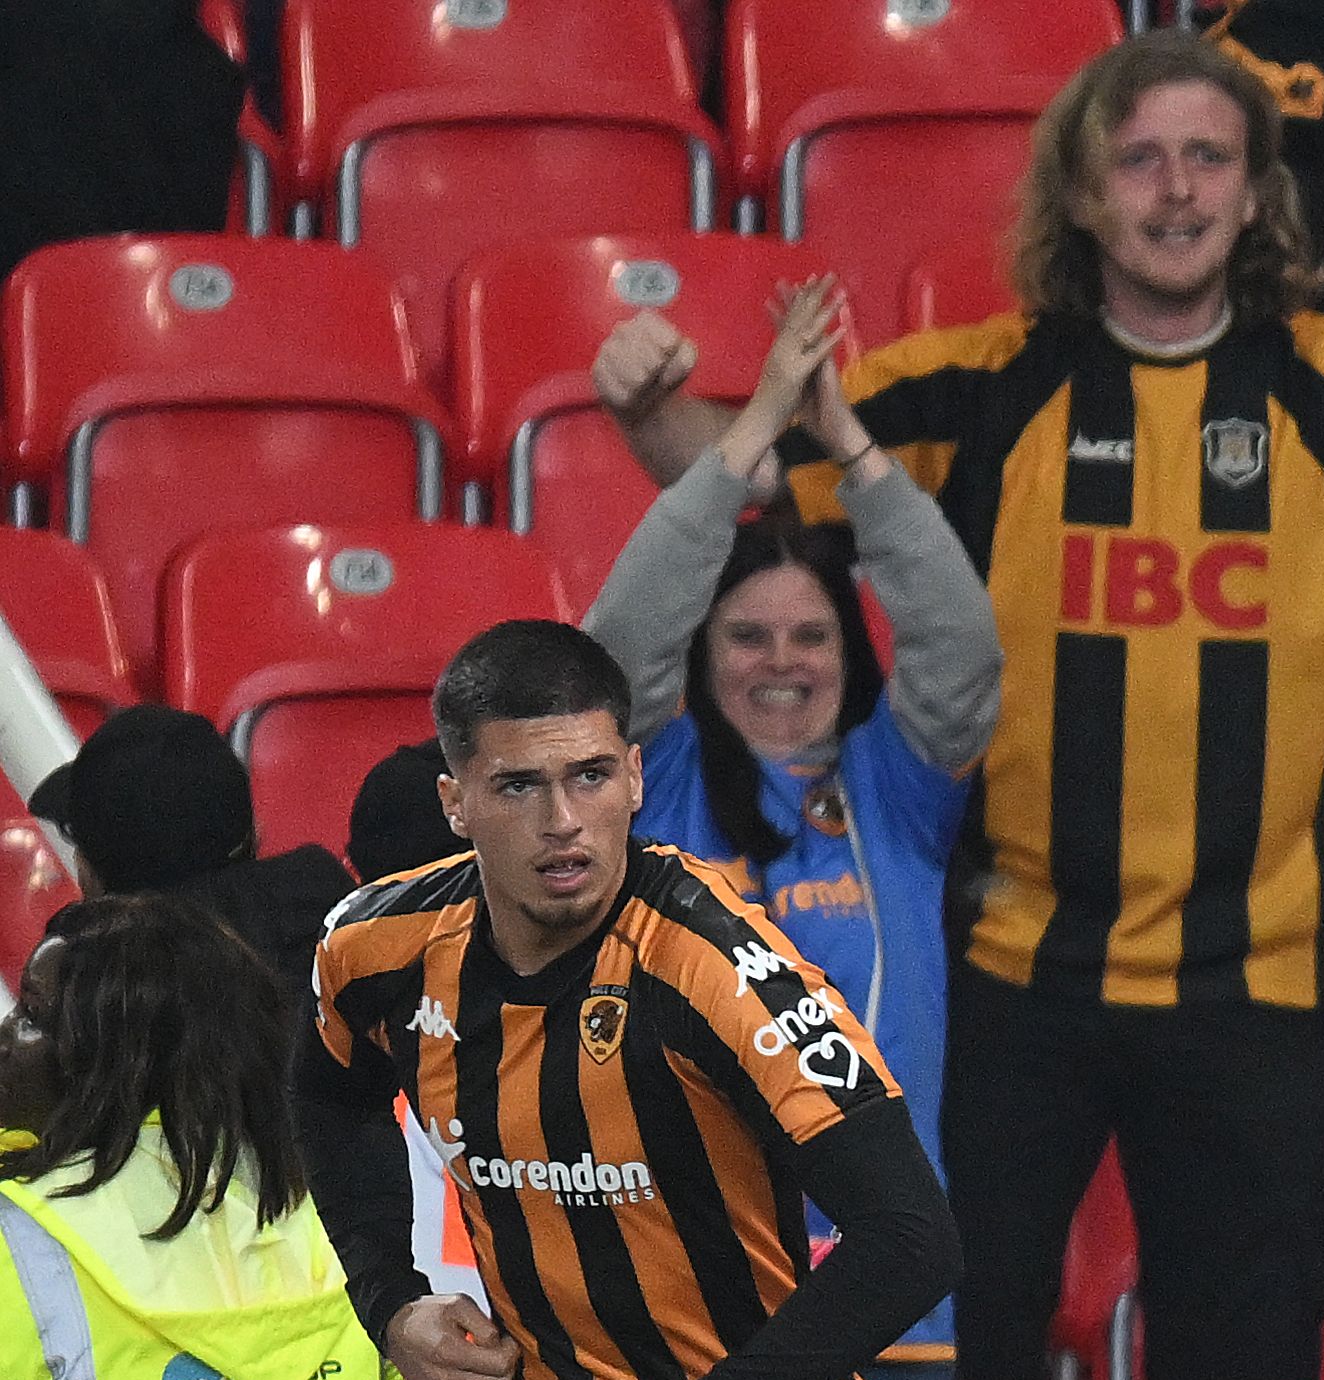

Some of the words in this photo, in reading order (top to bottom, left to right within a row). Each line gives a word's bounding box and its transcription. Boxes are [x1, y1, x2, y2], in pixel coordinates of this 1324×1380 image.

[1062, 534, 1268, 629] IBC
[753, 987, 844, 1056] anex
[469, 1153, 651, 1193] corendon
[554, 1188, 655, 1207] AIRLINES
